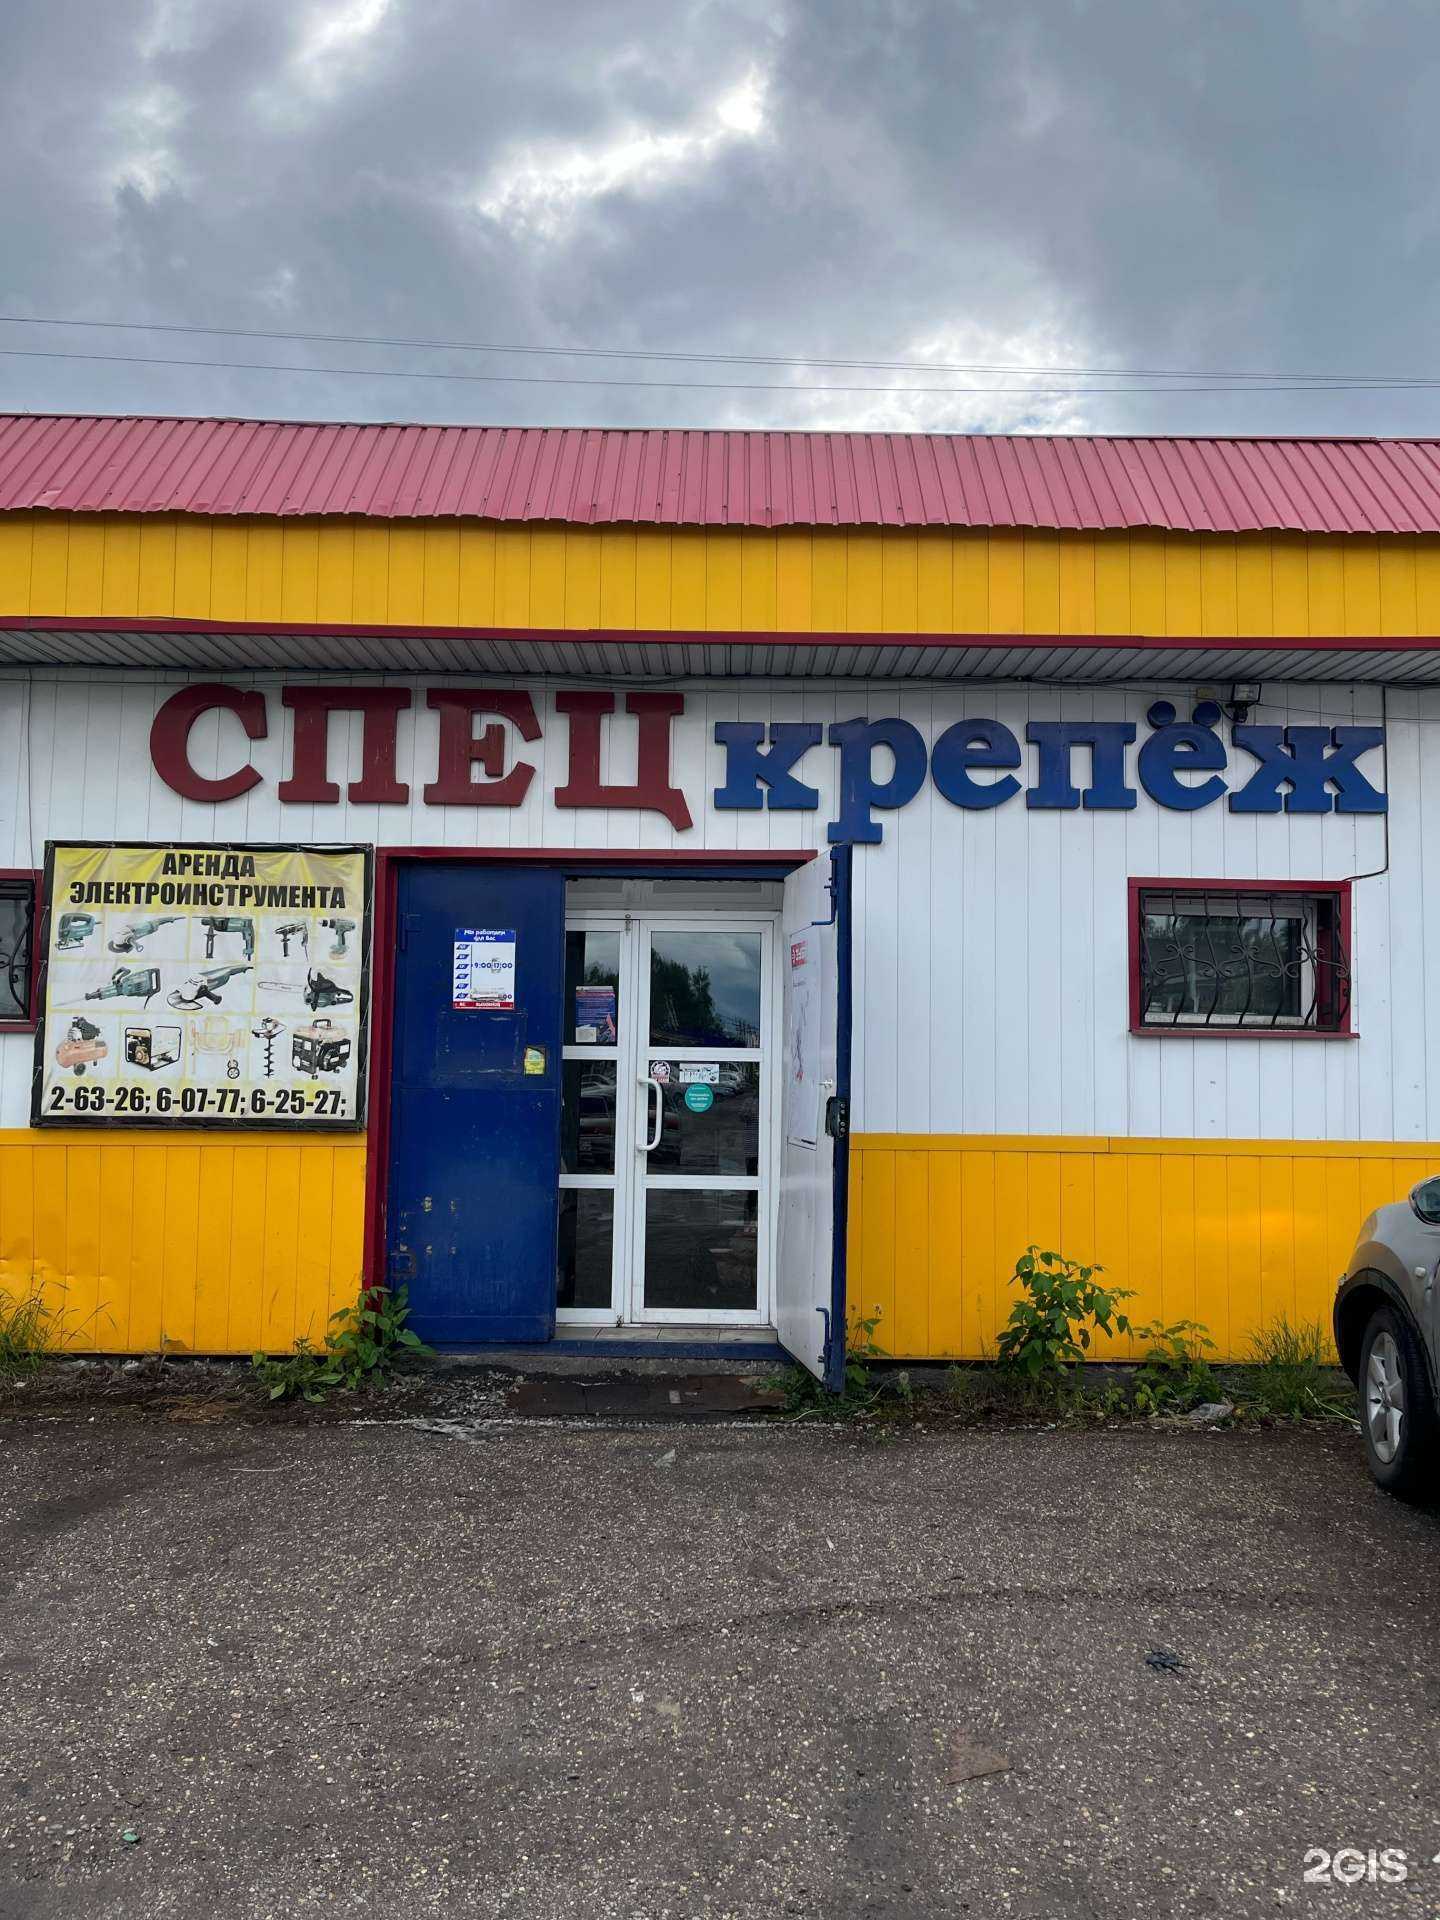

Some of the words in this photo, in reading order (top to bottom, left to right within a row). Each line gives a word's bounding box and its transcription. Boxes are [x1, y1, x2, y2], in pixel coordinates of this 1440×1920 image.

[162, 852, 256, 881] АРЕНДА
[69, 881, 347, 909] ЭЛЕКТРОИНСТРУМЕНТА
[50, 1086, 151, 1114] 2-63-26;
[156, 1087, 246, 1116] 6-07-77;
[251, 1088, 347, 1118] 6-25-27;
